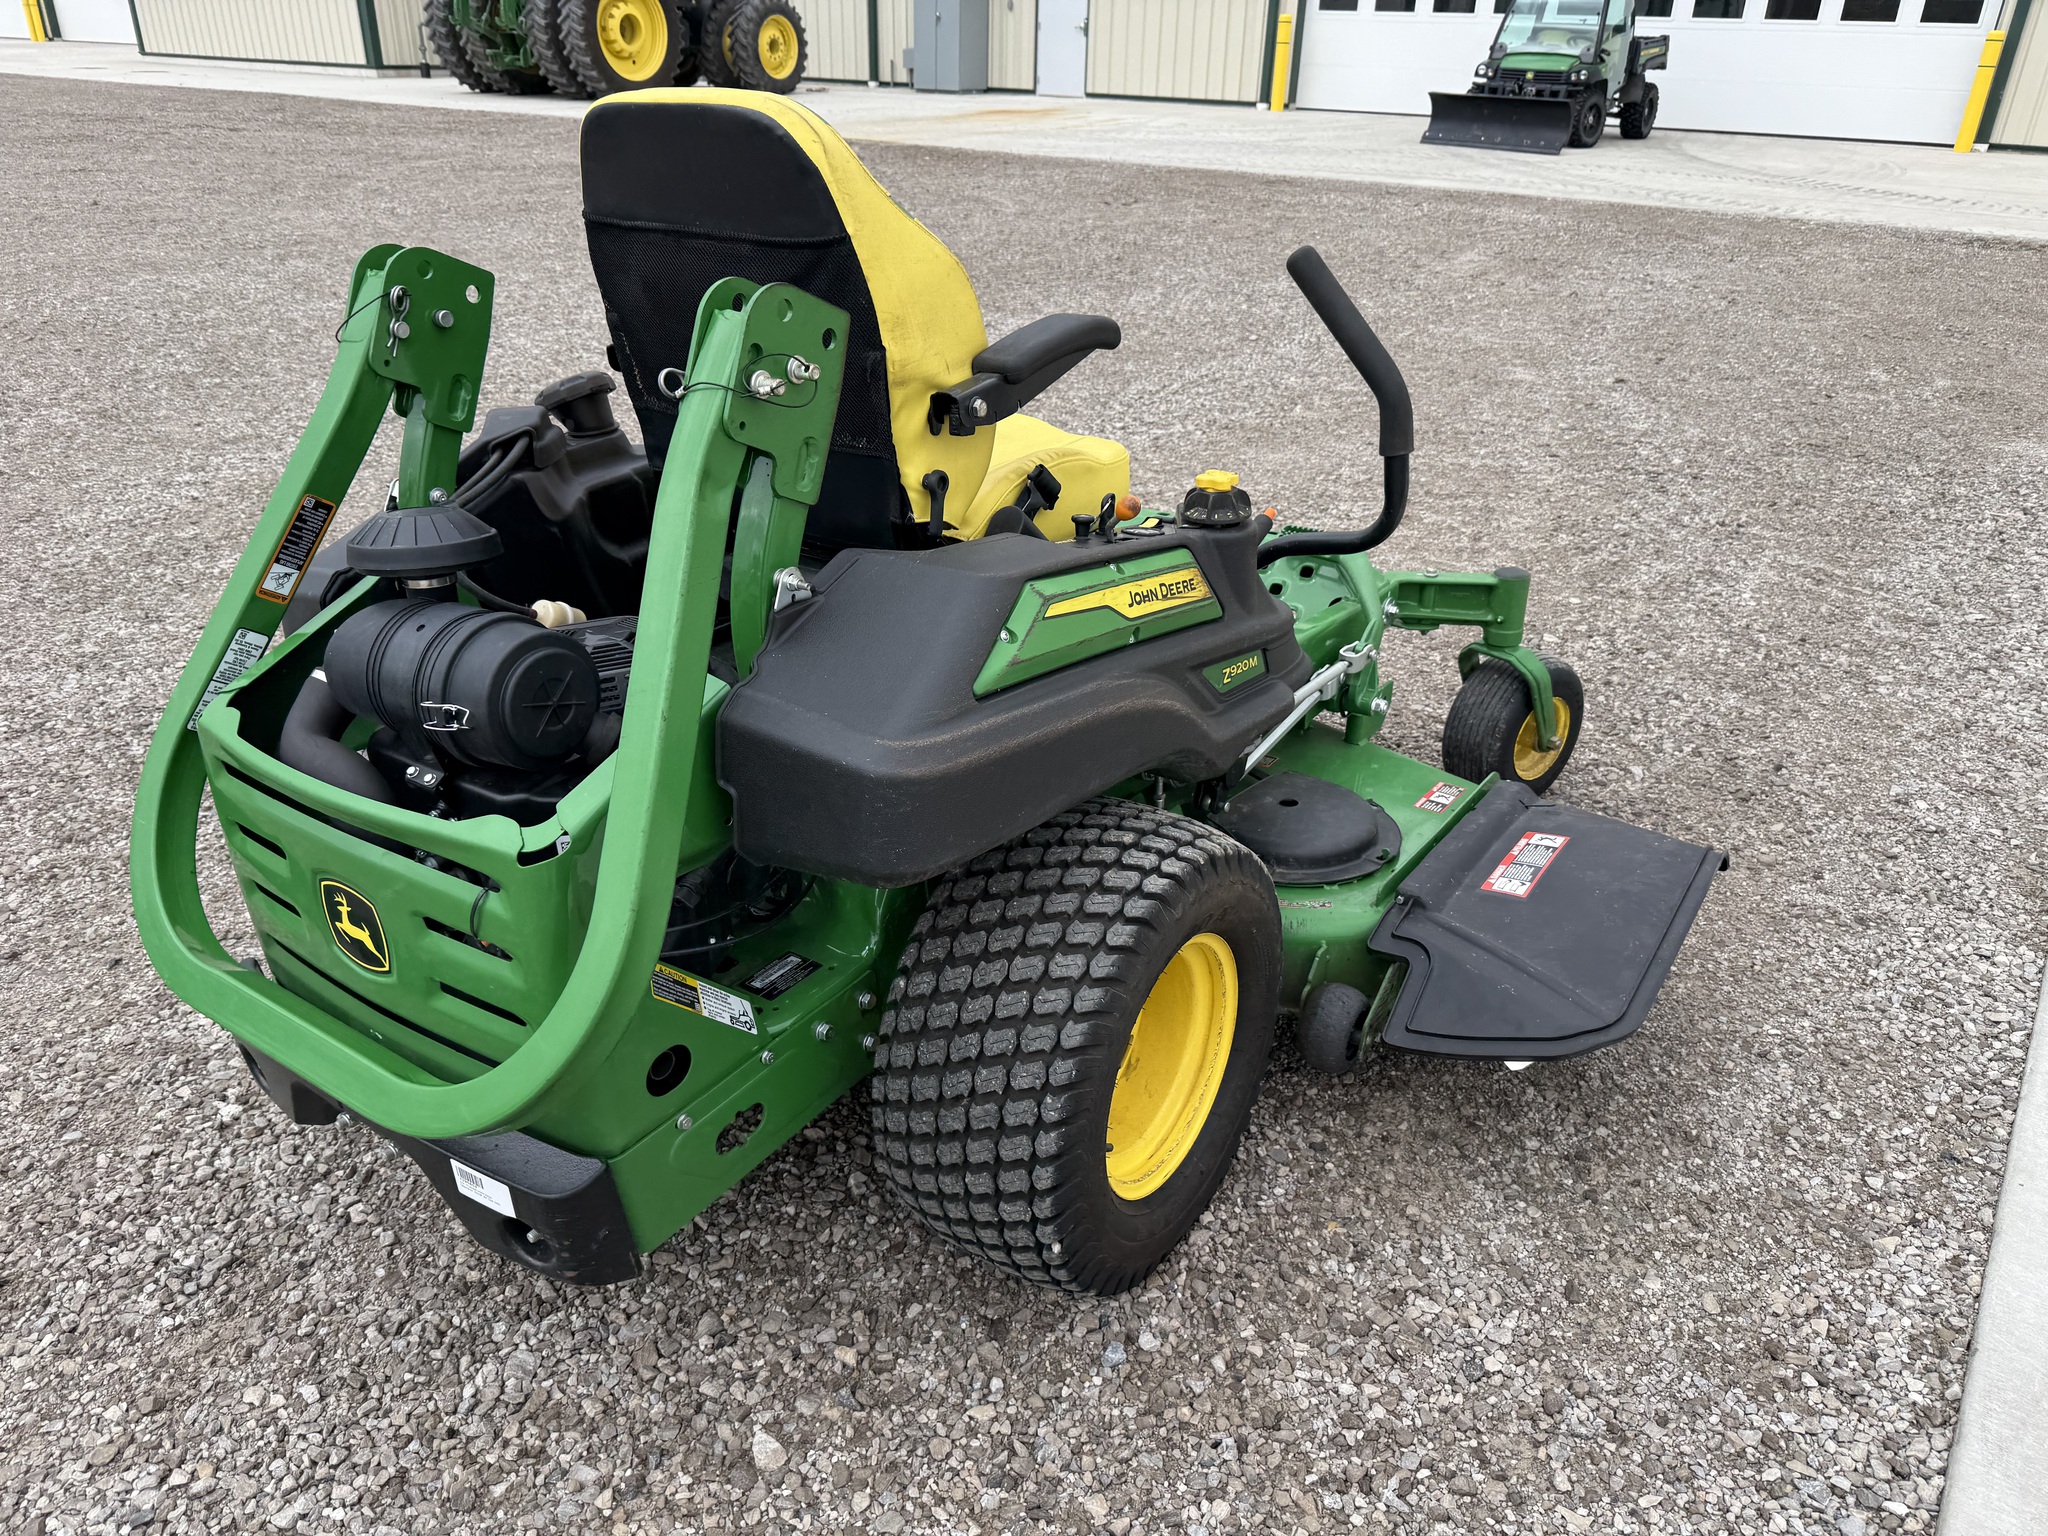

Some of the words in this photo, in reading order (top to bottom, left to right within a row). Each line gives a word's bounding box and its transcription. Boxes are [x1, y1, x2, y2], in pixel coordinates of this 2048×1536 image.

[1128, 587, 1159, 608] JOHN
[1159, 578, 1197, 599] DEERE
[1222, 655, 1258, 684] Z920M
[663, 968, 688, 983] CAUTION
